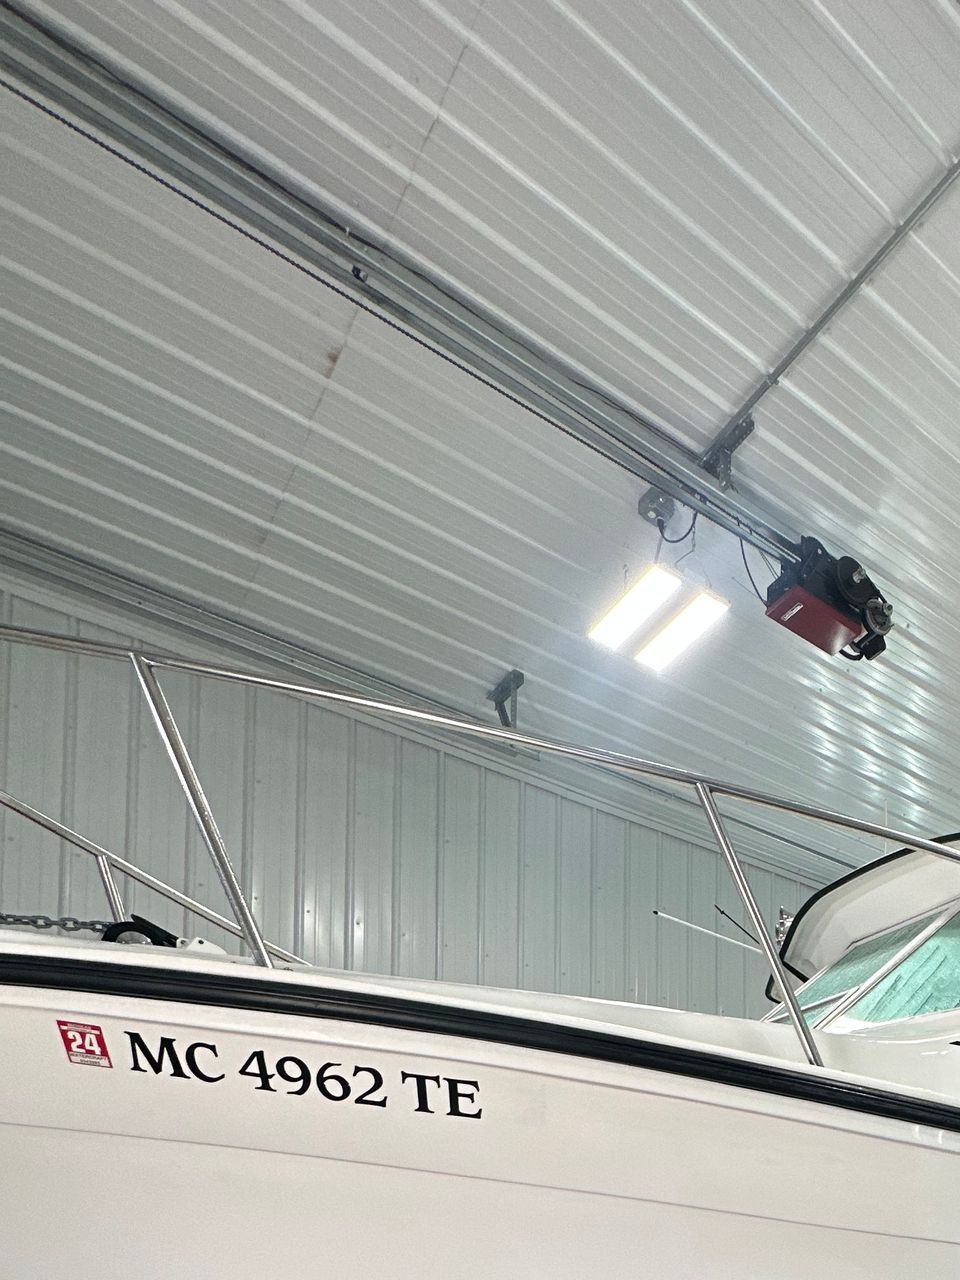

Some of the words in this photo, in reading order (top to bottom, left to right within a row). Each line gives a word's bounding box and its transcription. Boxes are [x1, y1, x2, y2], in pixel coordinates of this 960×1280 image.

[66, 1030, 102, 1055] 24
[124, 1030, 225, 1082] MC
[239, 1049, 388, 1107] 4962
[401, 1070, 483, 1120] TE
